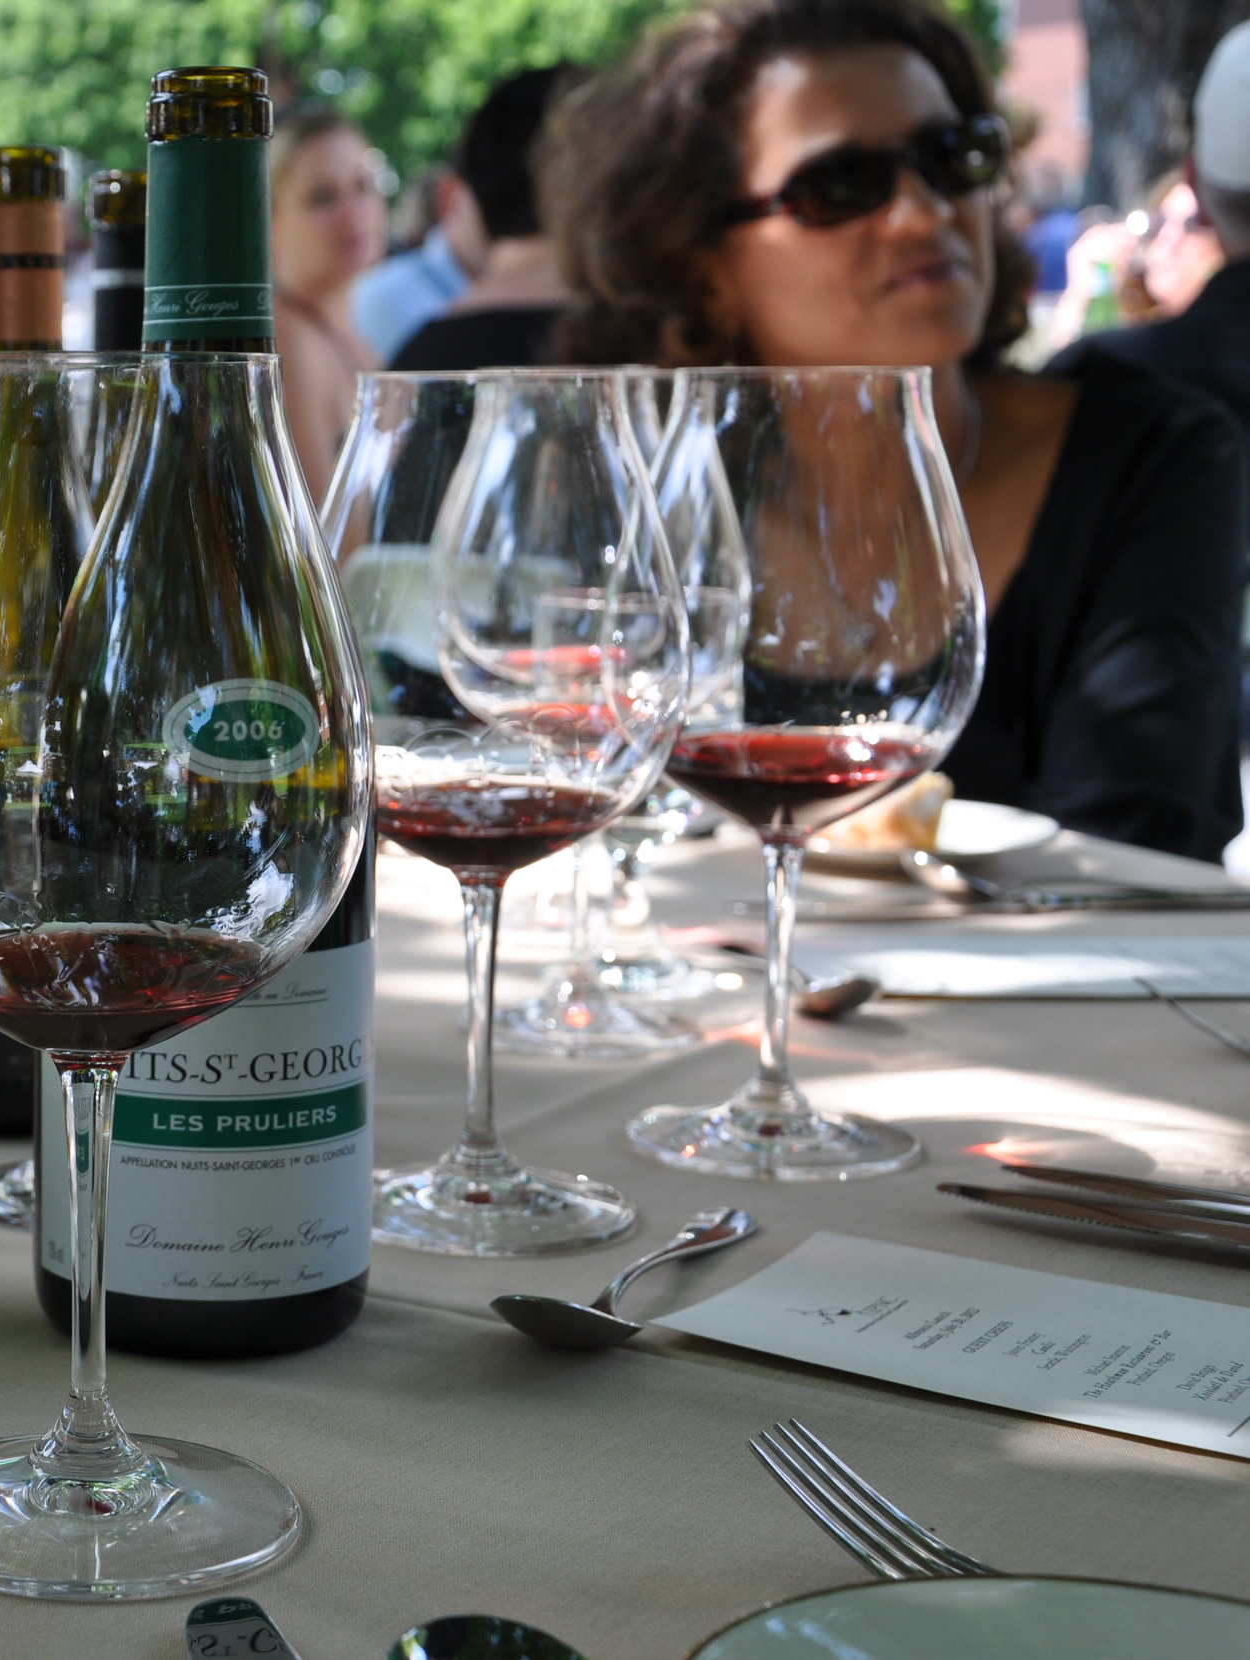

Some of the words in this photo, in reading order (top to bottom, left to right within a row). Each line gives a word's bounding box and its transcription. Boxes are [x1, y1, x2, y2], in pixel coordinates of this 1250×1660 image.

[185, 290, 239, 317] Gouges
[213, 720, 283, 742] 2006
[152, 1112, 204, 1132] LES
[216, 1105, 337, 1132] PRULIERS
[120, 1155, 178, 1170] APPELLATION
[304, 1154, 320, 1165] CRU
[125, 1223, 225, 1252] Domaine
[230, 1226, 297, 1254] Henri
[297, 1218, 350, 1250] Gouges
[962, 1336, 991, 1353] GUEST
[984, 1321, 1013, 1337] CHEFS
[1083, 1389, 1103, 1398] The
[1094, 1368, 1129, 1390] Heathman
[1120, 1345, 1155, 1368] Restaurant
[1154, 1330, 1171, 1339] Bar
[1219, 1361, 1244, 1377] David
[1176, 1377, 1202, 1391] David
[1190, 1365, 1218, 1378] Briggs
